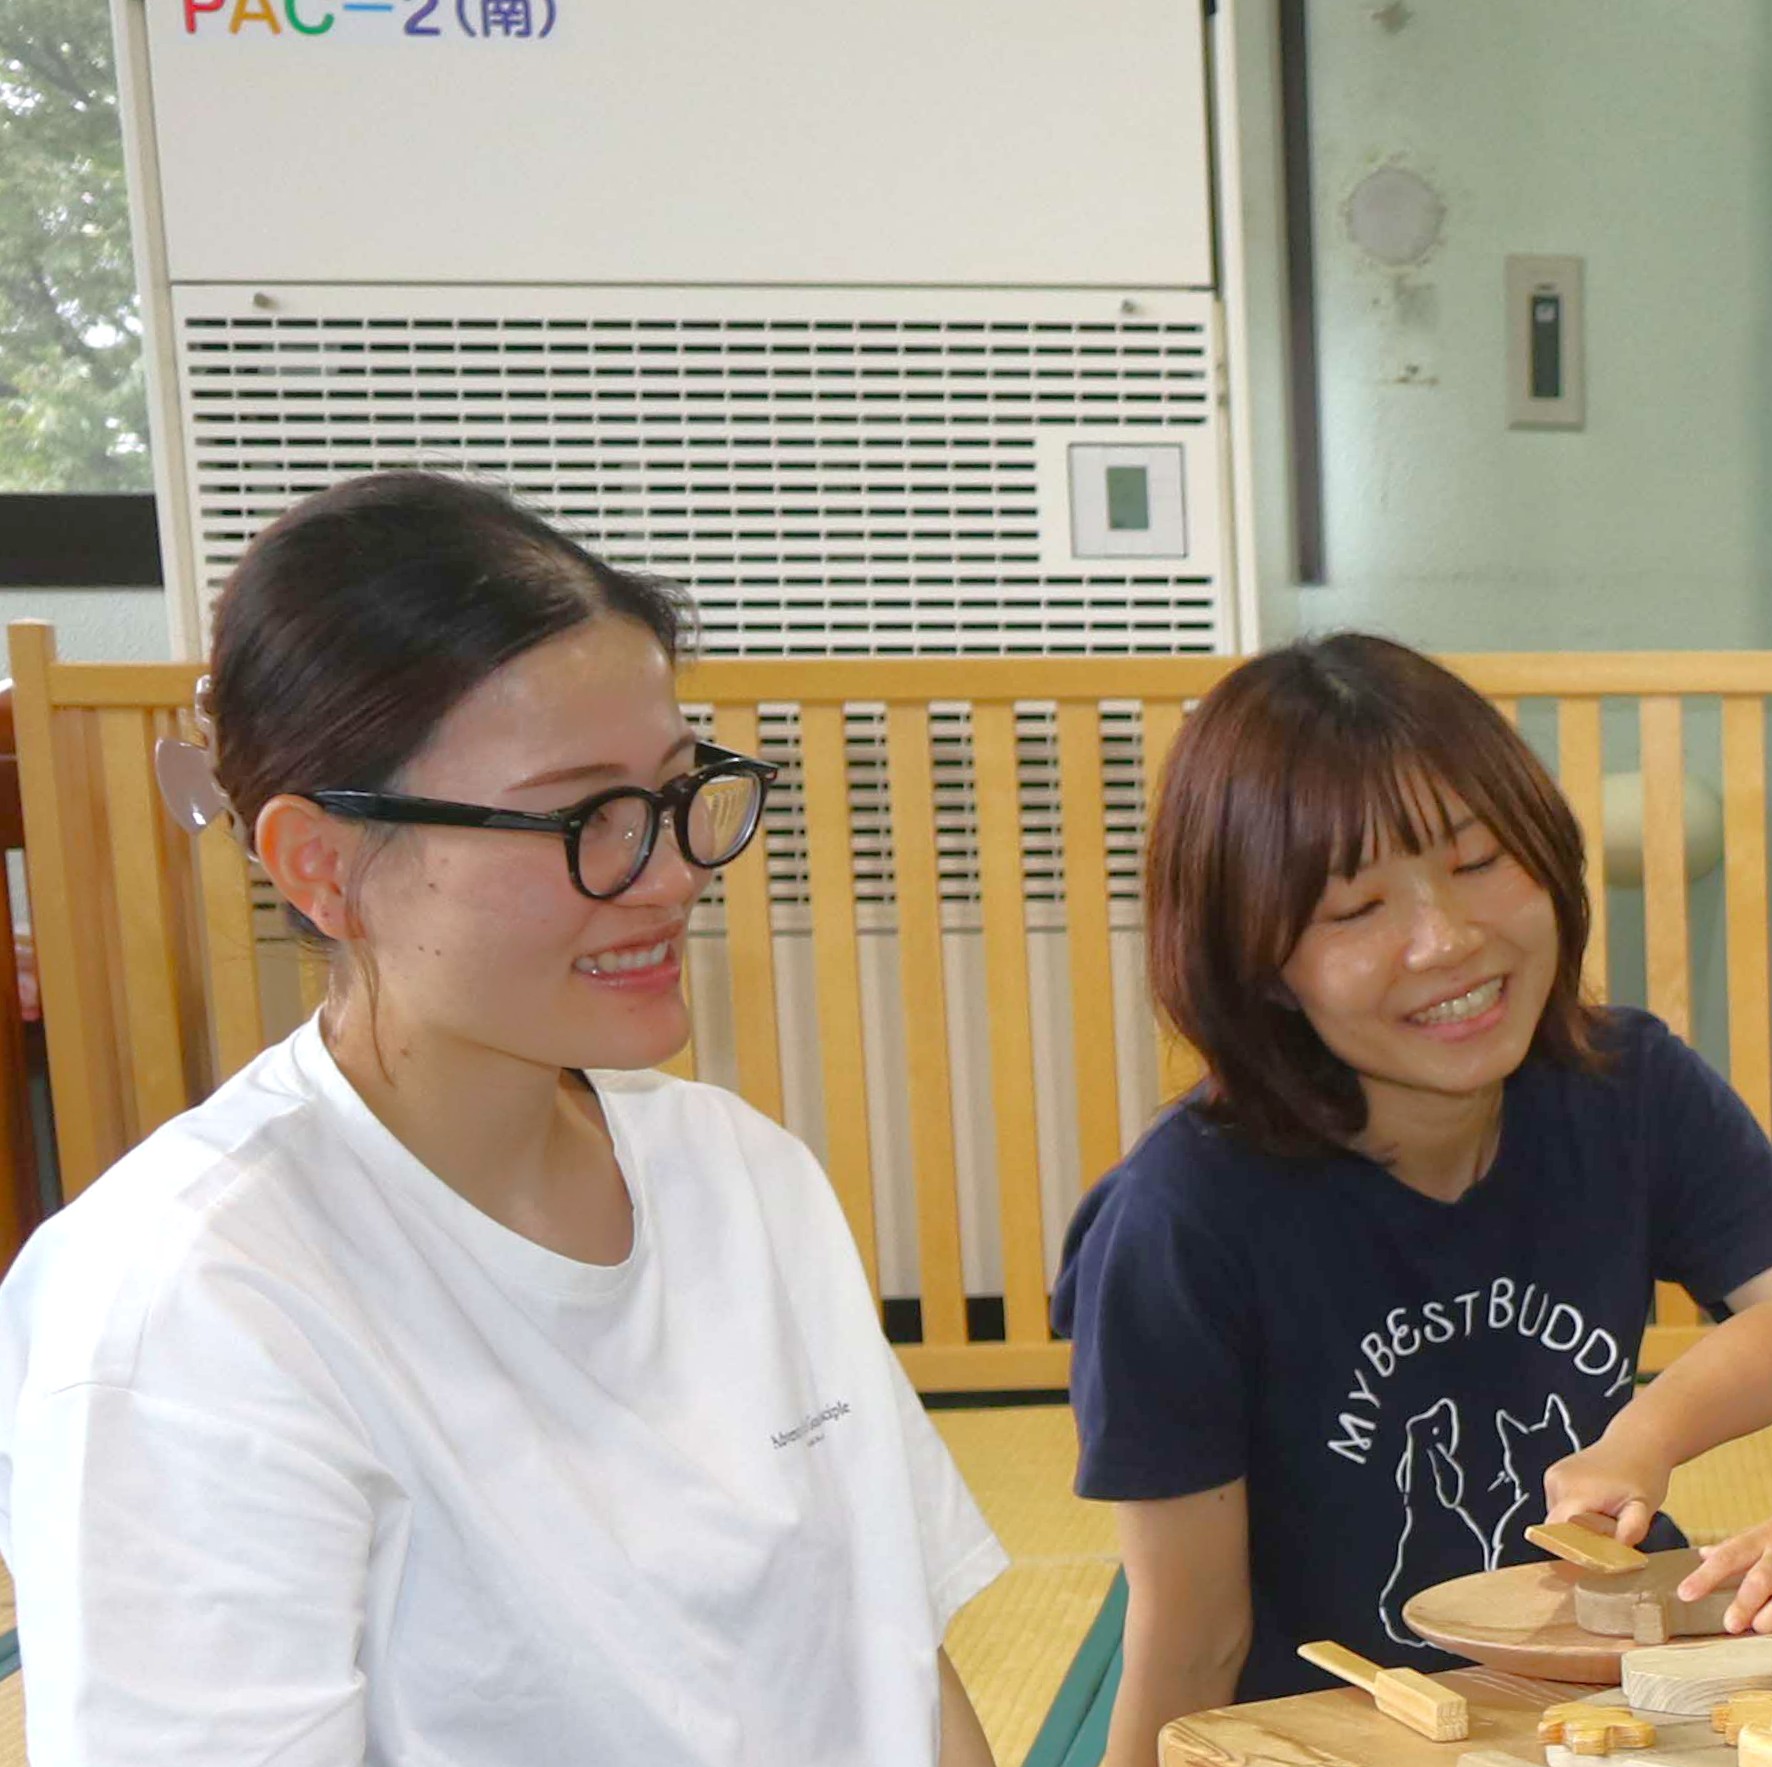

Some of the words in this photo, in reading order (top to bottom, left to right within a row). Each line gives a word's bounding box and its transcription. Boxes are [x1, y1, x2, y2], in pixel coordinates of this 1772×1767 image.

[1327, 1368, 1381, 1465] MY
[1361, 1291, 1480, 1378] BEST
[1488, 1276, 1633, 1398] BUDDY
